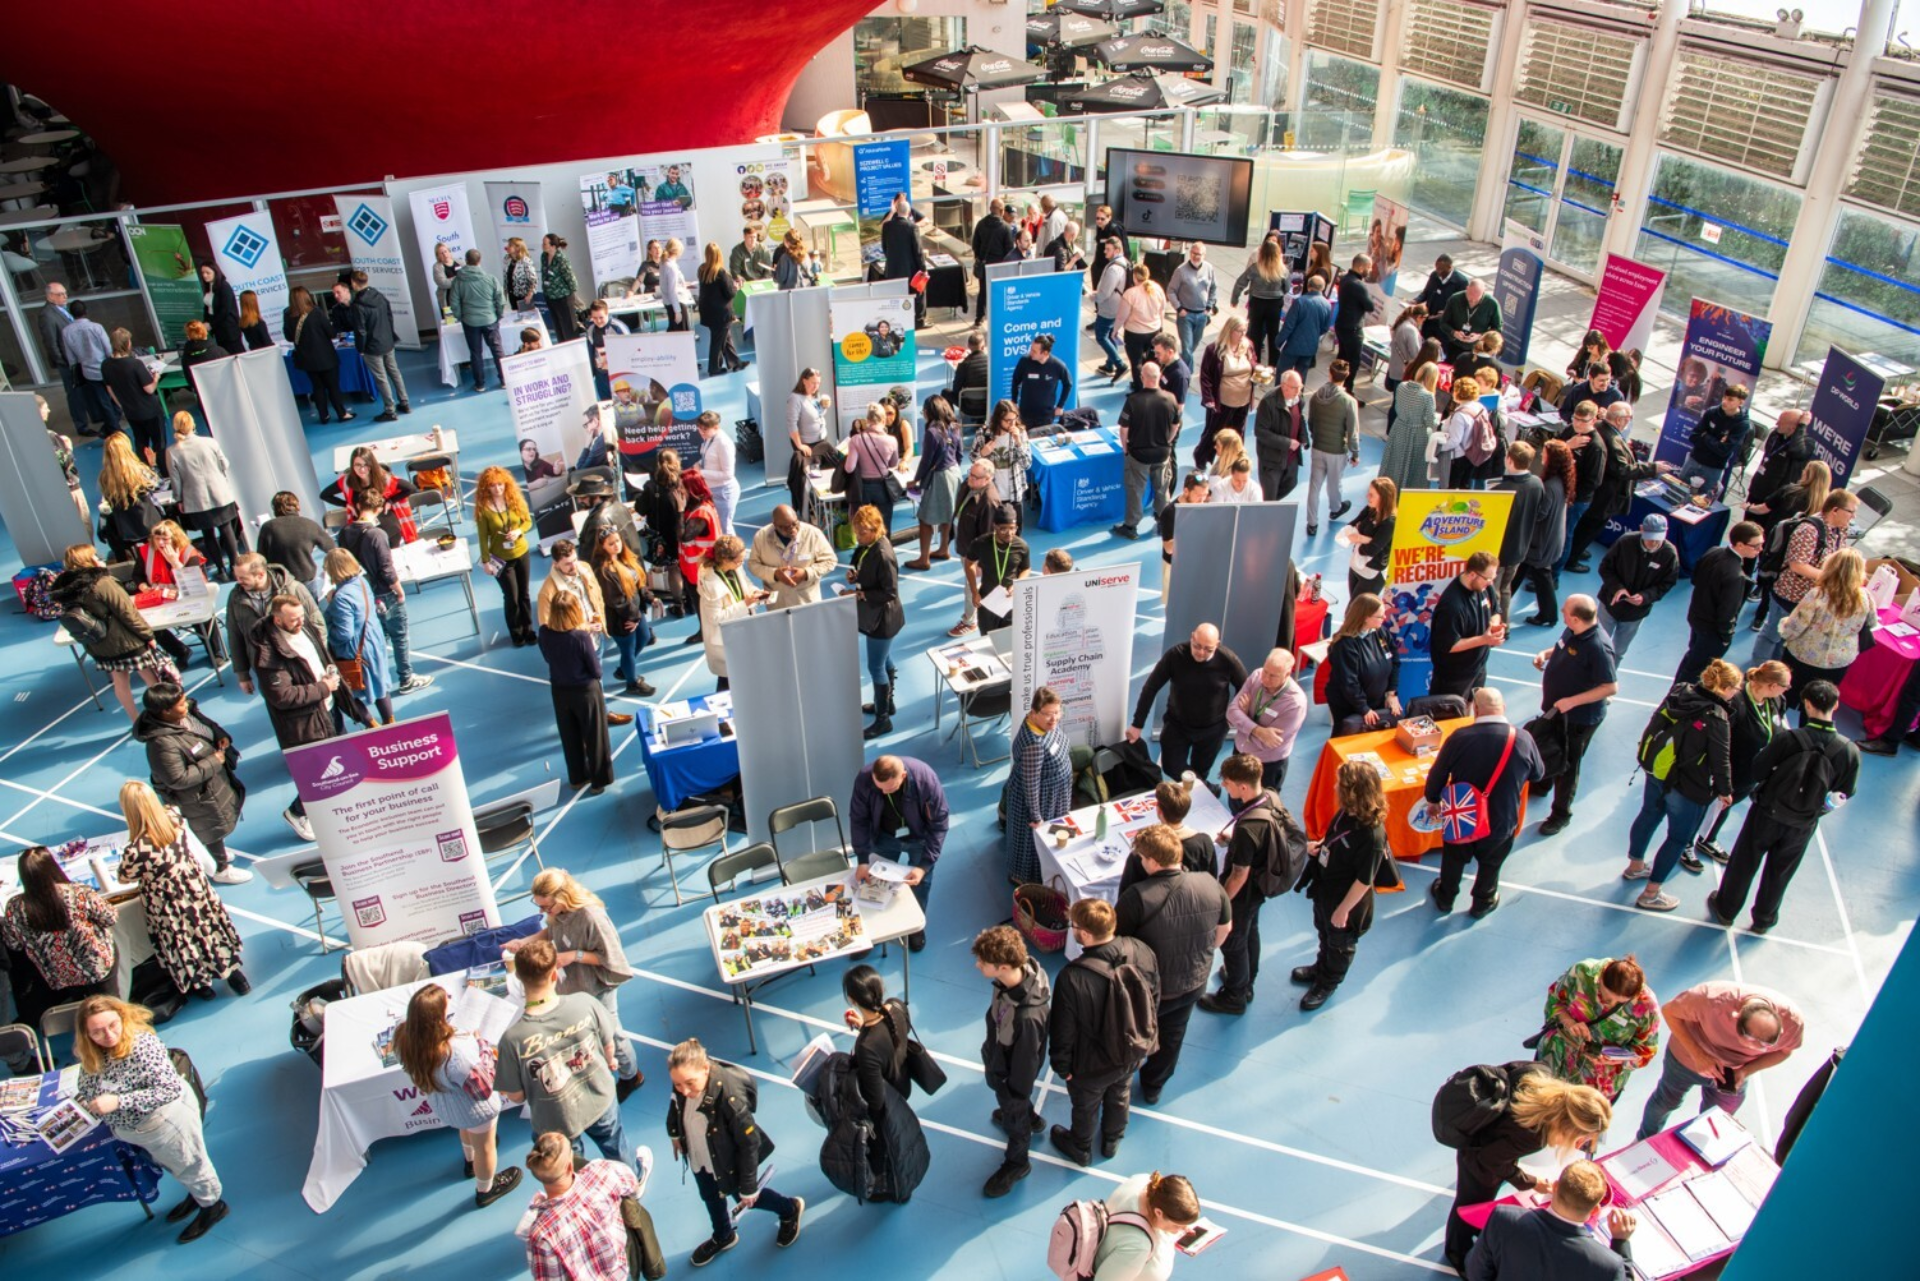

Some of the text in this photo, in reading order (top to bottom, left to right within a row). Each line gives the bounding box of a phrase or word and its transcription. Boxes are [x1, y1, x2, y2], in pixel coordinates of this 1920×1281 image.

[436, 232, 460, 242] South
[372, 266, 404, 274] SERVICES
[232, 274, 283, 291] OUTH COAST
[1620, 277, 1634, 286] across
[1634, 281, 1648, 290] Essex
[1628, 271, 1658, 286] employment
[257, 284, 286, 295] ERVICES
[1004, 318, 1062, 334] Come and
[1004, 333, 1032, 346] work
[1699, 336, 1746, 358] ENGINEER
[1690, 342, 1752, 370] YOUR FUTURE
[514, 374, 570, 396] IN WORK AND
[516, 382, 572, 406] STRUGGLING?
[1830, 386, 1860, 410] DP WORLD
[520, 415, 545, 426] employment
[624, 423, 697, 434] Need help getting
[665, 433, 690, 441] work?
[1813, 416, 1852, 456] WE'RE
[1814, 441, 1846, 476] IRING
[1102, 484, 1122, 492] Vehicle
[1076, 502, 1098, 510] Agency
[1077, 494, 1107, 502] Standards
[1420, 516, 1485, 532] ADVENTURE
[1432, 522, 1470, 537] ISLAND
[1394, 545, 1446, 566] WE'RE
[1046, 630, 1077, 639] Education
[1022, 586, 1033, 712] make us true professionals
[1046, 656, 1076, 668] Supply
[1078, 652, 1103, 662] Chain
[1051, 663, 1091, 674] Academy
[1047, 678, 1075, 686] learning
[368, 733, 439, 758] Business
[377, 746, 442, 769] Support
[312, 772, 359, 788] Southend-on-Sea
[333, 778, 354, 788] Council
[332, 783, 439, 816] The first point of call
[345, 795, 433, 822] for your business
[351, 820, 378, 830] Economic
[380, 812, 406, 822] inclusion
[365, 826, 382, 834] touch
[407, 815, 420, 823] right
[422, 811, 442, 820] people
[388, 824, 414, 833] business
[370, 848, 404, 862] Southend
[342, 866, 372, 876] Business
[374, 853, 414, 868] Partnership
[392, 892, 407, 900] Sign
[443, 875, 476, 887] Southend
[415, 881, 477, 899] Business Directory
[520, 1016, 592, 1058] Bronco
[405, 1118, 441, 1129] Busin
